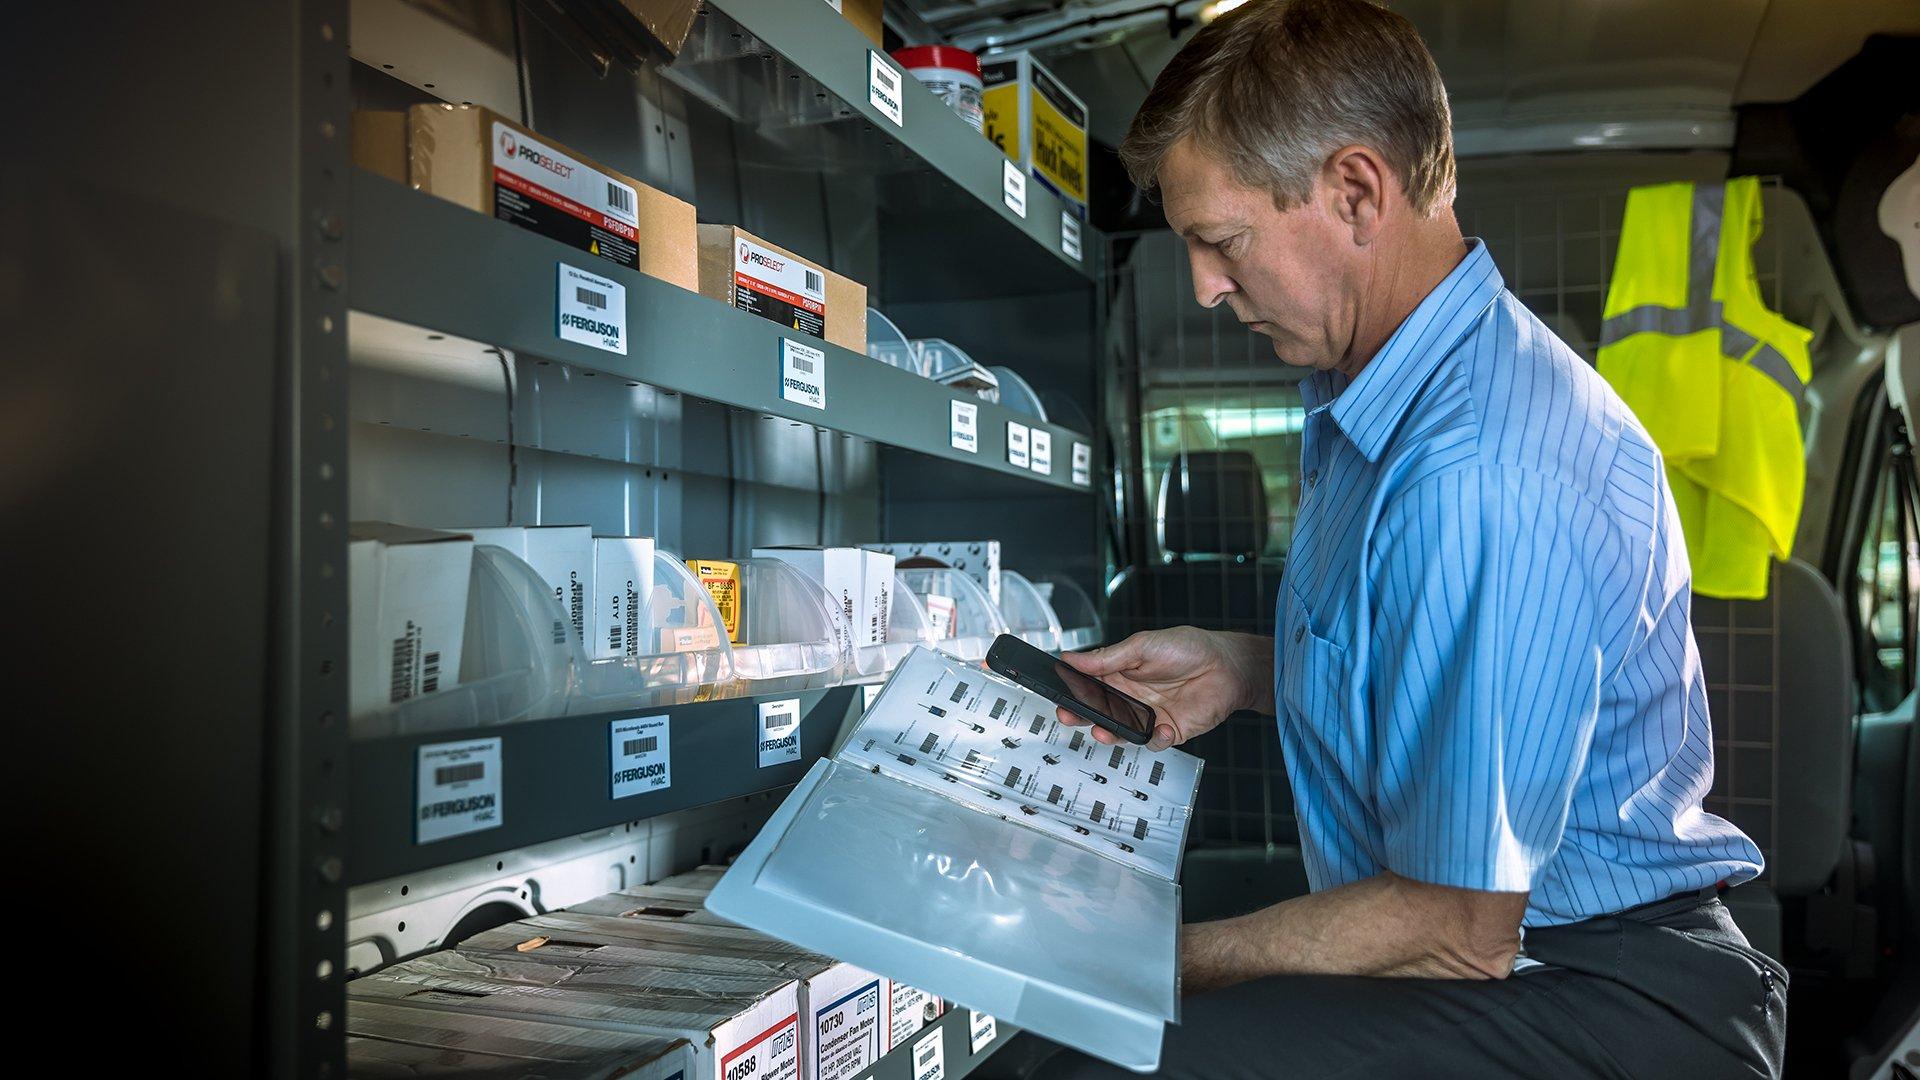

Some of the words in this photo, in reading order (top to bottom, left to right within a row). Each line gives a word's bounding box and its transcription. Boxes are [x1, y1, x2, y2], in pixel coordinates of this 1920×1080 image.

[519, 145, 572, 179] PROSELECT
[751, 252, 784, 273] PROSELECT
[571, 315, 619, 338] FERGUSON
[603, 338, 619, 349] HVAC
[790, 379, 820, 396] FERGUSON
[766, 736, 796, 751] FERGUSON
[776, 747, 797, 755] HVAC
[622, 762, 665, 782] FERGUSON
[651, 776, 665, 786] HVAC
[433, 793, 496, 817] FERGUSON
[820, 1011, 844, 1036] 10730
[821, 1031, 849, 1054] Condenser
[849, 1025, 859, 1037] Fan
[860, 1016, 875, 1031] Motor
[727, 1055, 756, 1080] 10588
[780, 1056, 795, 1071] Motor
